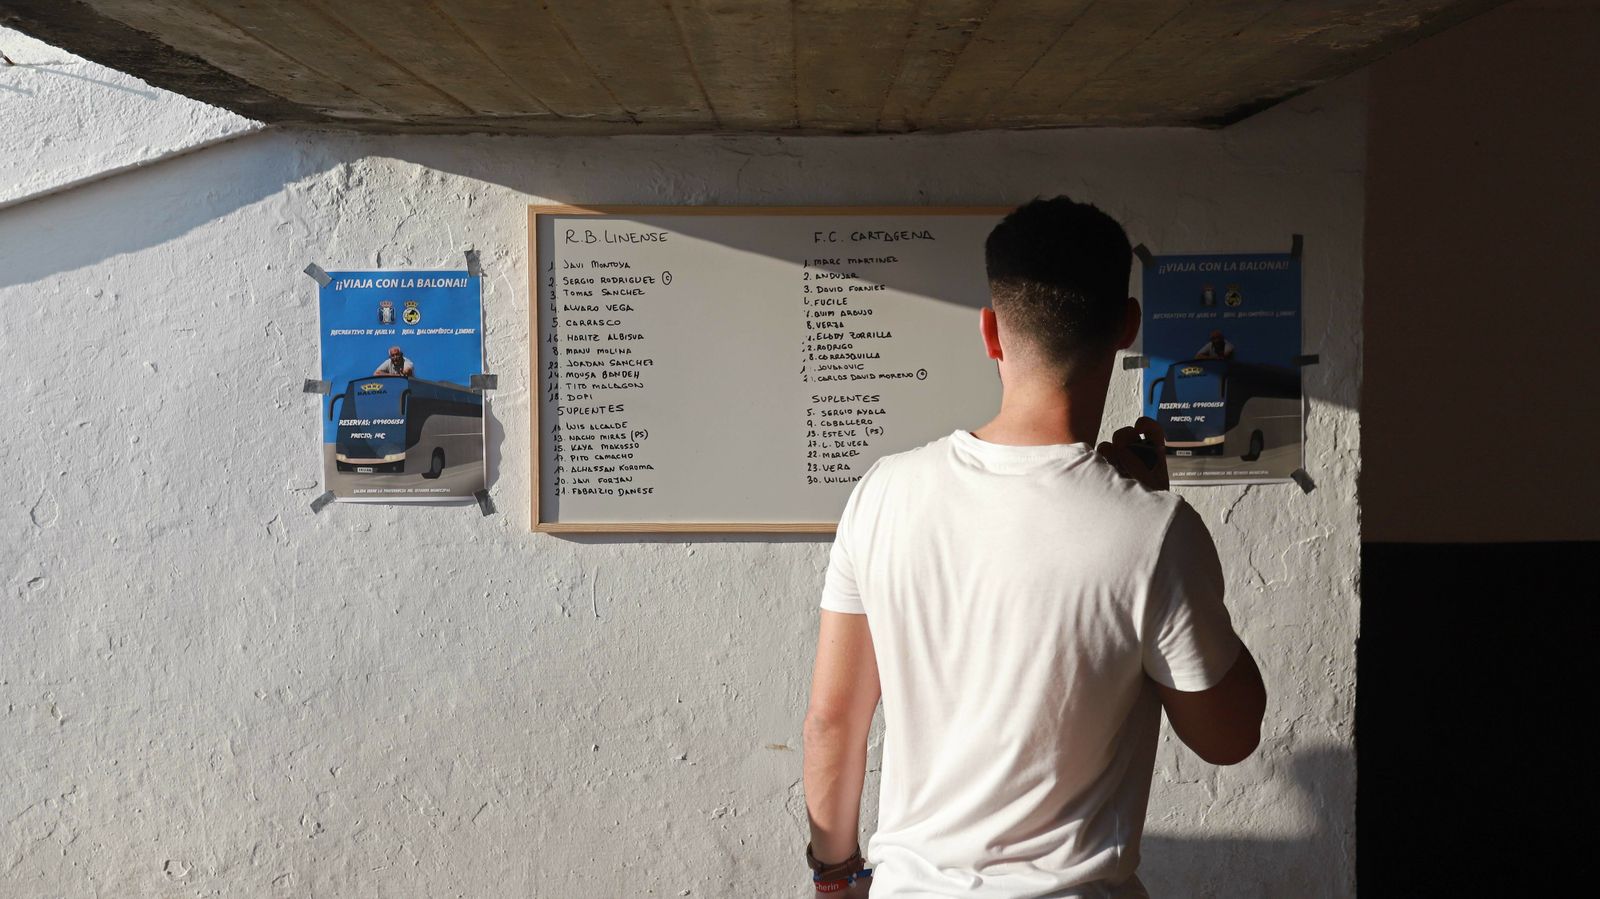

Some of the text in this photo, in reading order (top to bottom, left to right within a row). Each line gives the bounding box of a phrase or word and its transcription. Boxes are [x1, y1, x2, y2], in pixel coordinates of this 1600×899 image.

[565, 229, 668, 244] R.B. LINENSE
[814, 231, 935, 243] F.C. CARTAGENA
[563, 260, 584, 269] JAVI
[591, 260, 631, 269] MONTOYA
[848, 256, 899, 265] MARTINEZ
[1159, 261, 1289, 275] ¡¡VIAJA CON LA BALONA!!
[336, 278, 467, 291] ¡¡VIAJA CON LA BALONA!!
[563, 277, 595, 286] SERGIO
[600, 276, 655, 284] RODRIGUEZ
[804, 284, 886, 294] 3. DAVID FORNIES
[814, 297, 848, 306] FUCILE
[563, 304, 599, 312] ALVARO
[606, 304, 634, 312] VEGA
[814, 310, 835, 318] QUIM
[841, 309, 873, 317] ARAUJO
[567, 334, 600, 342] HARITZ
[608, 333, 644, 341] ALBISUA
[849, 331, 893, 339] ZORRILLA
[609, 359, 654, 367] SANCHEZ
[602, 371, 640, 379] BANDEH
[851, 373, 876, 381] DAVID
[812, 394, 880, 403] SUPLENTES
[557, 404, 625, 416] SUPLENTES
[1159, 402, 1191, 410] RESERVAS:
[807, 408, 886, 417] 5. SERGIO AYALA
[566, 422, 586, 431] LUIS
[590, 422, 628, 431] ALCALDE
[807, 419, 873, 428] 9. CABALLERO
[631, 429, 648, 442] (PS)
[823, 430, 857, 438] ESTEVE
[866, 426, 884, 437] (PS)
[823, 450, 860, 459] MARKEL
[808, 463, 851, 472] 23. VERA
[598, 476, 633, 484] FORJAN
[807, 475, 821, 485] 30.
[618, 488, 655, 496] DANESE
